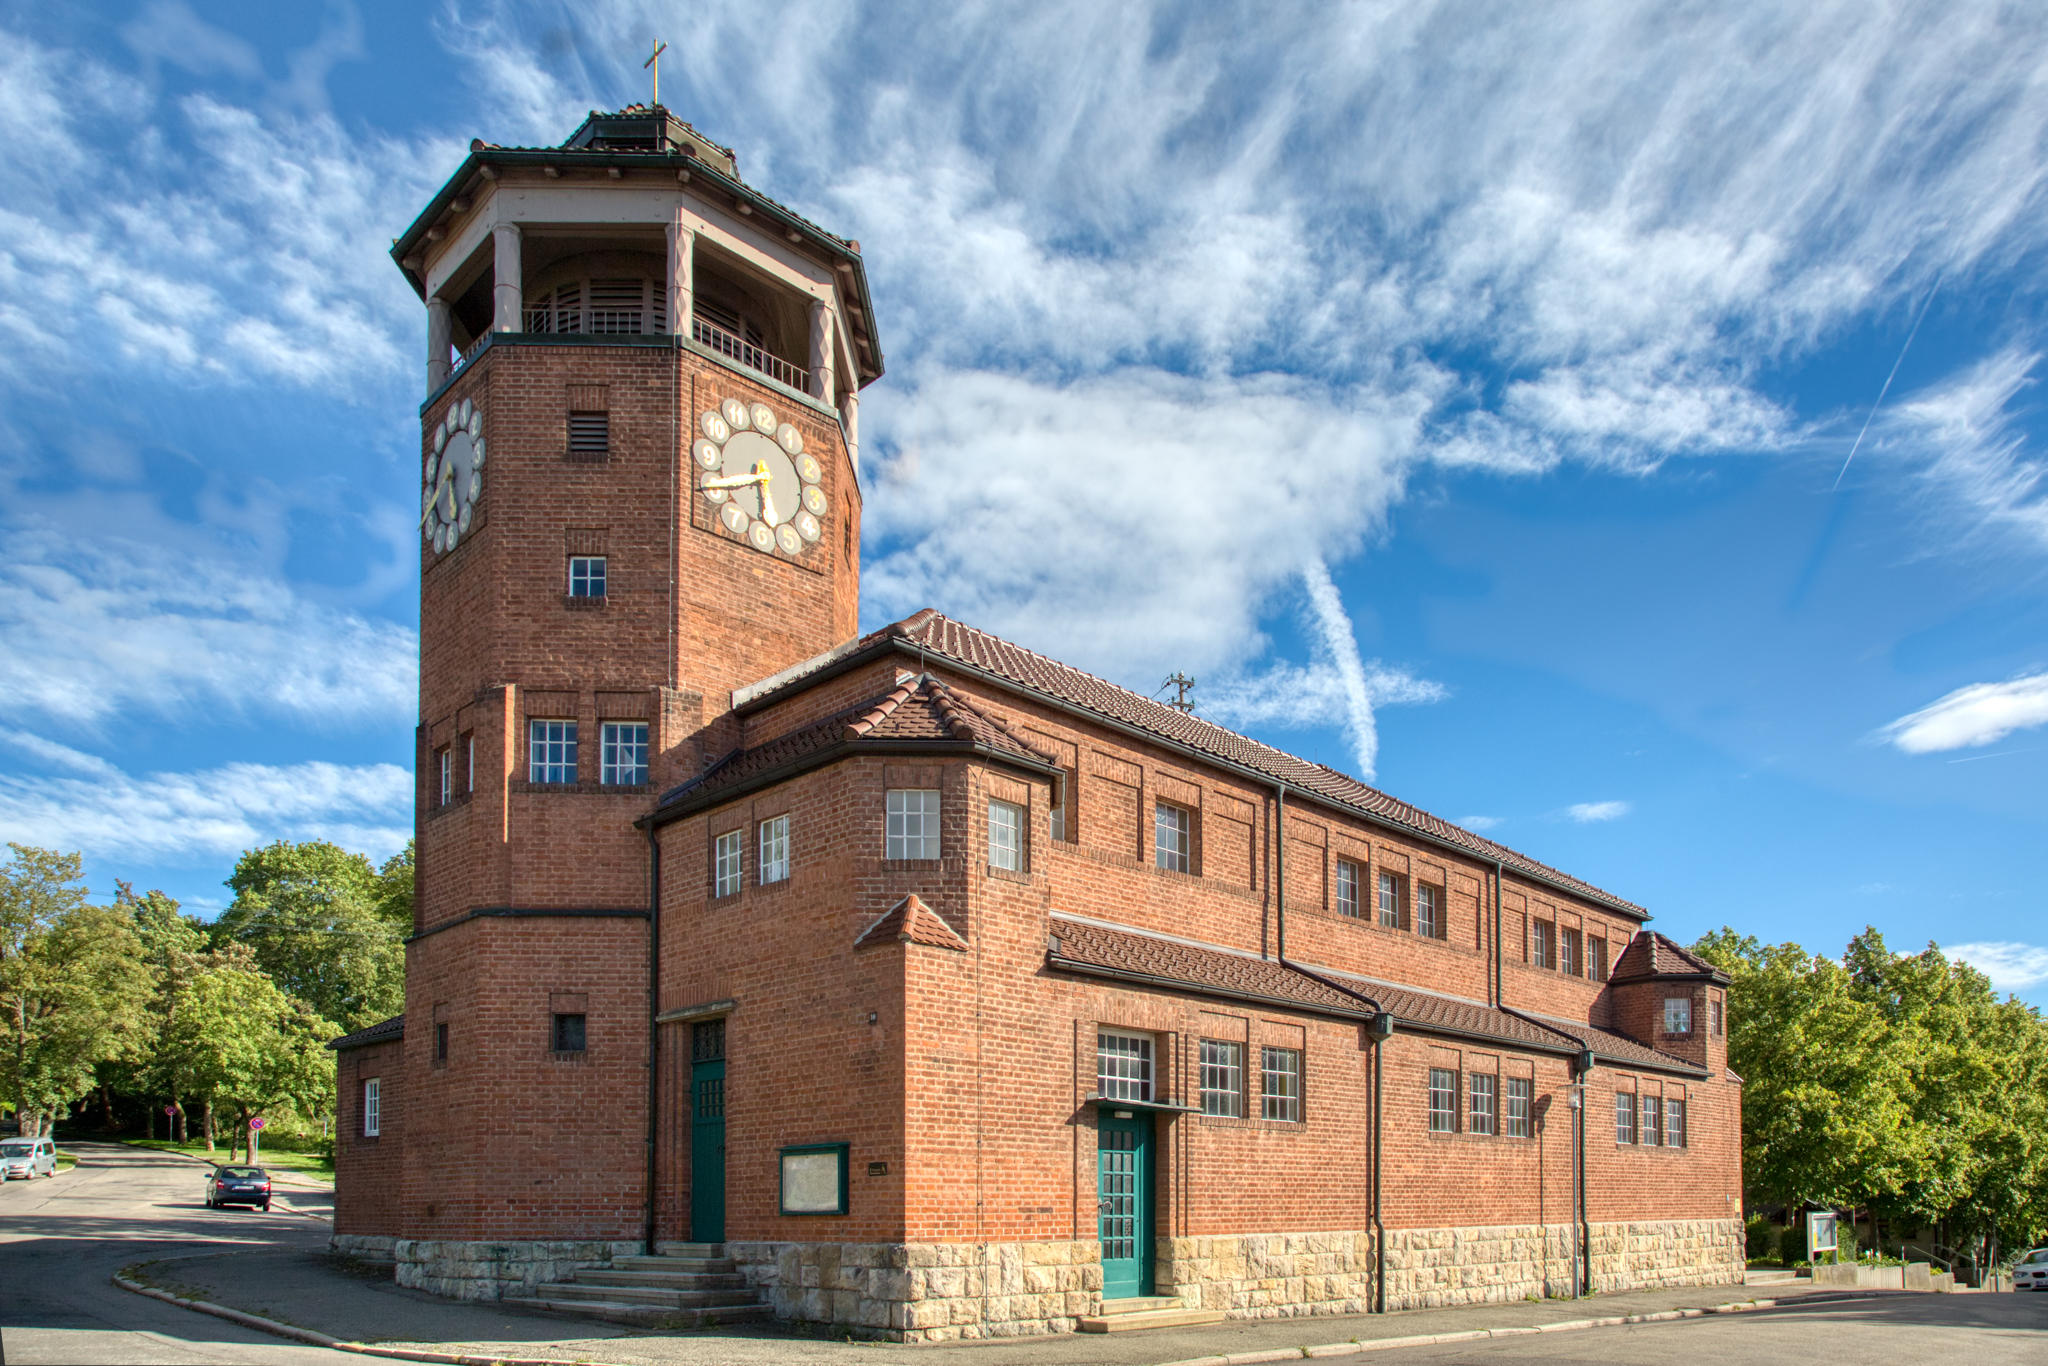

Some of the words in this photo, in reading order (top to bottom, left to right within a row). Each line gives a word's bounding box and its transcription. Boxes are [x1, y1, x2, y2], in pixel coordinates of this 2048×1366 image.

[729, 403, 744, 426] 11
[755, 407, 772, 430] 12
[706, 416, 725, 439] 10
[785, 428, 793, 449] 1
[474, 443, 481, 464] 3
[703, 444, 716, 466] 9
[803, 458, 815, 479] 2
[808, 489, 820, 510] 3
[728, 507, 742, 528] 7
[801, 516, 816, 537] 4
[755, 525, 768, 545] 6
[783, 528, 795, 549] 5
